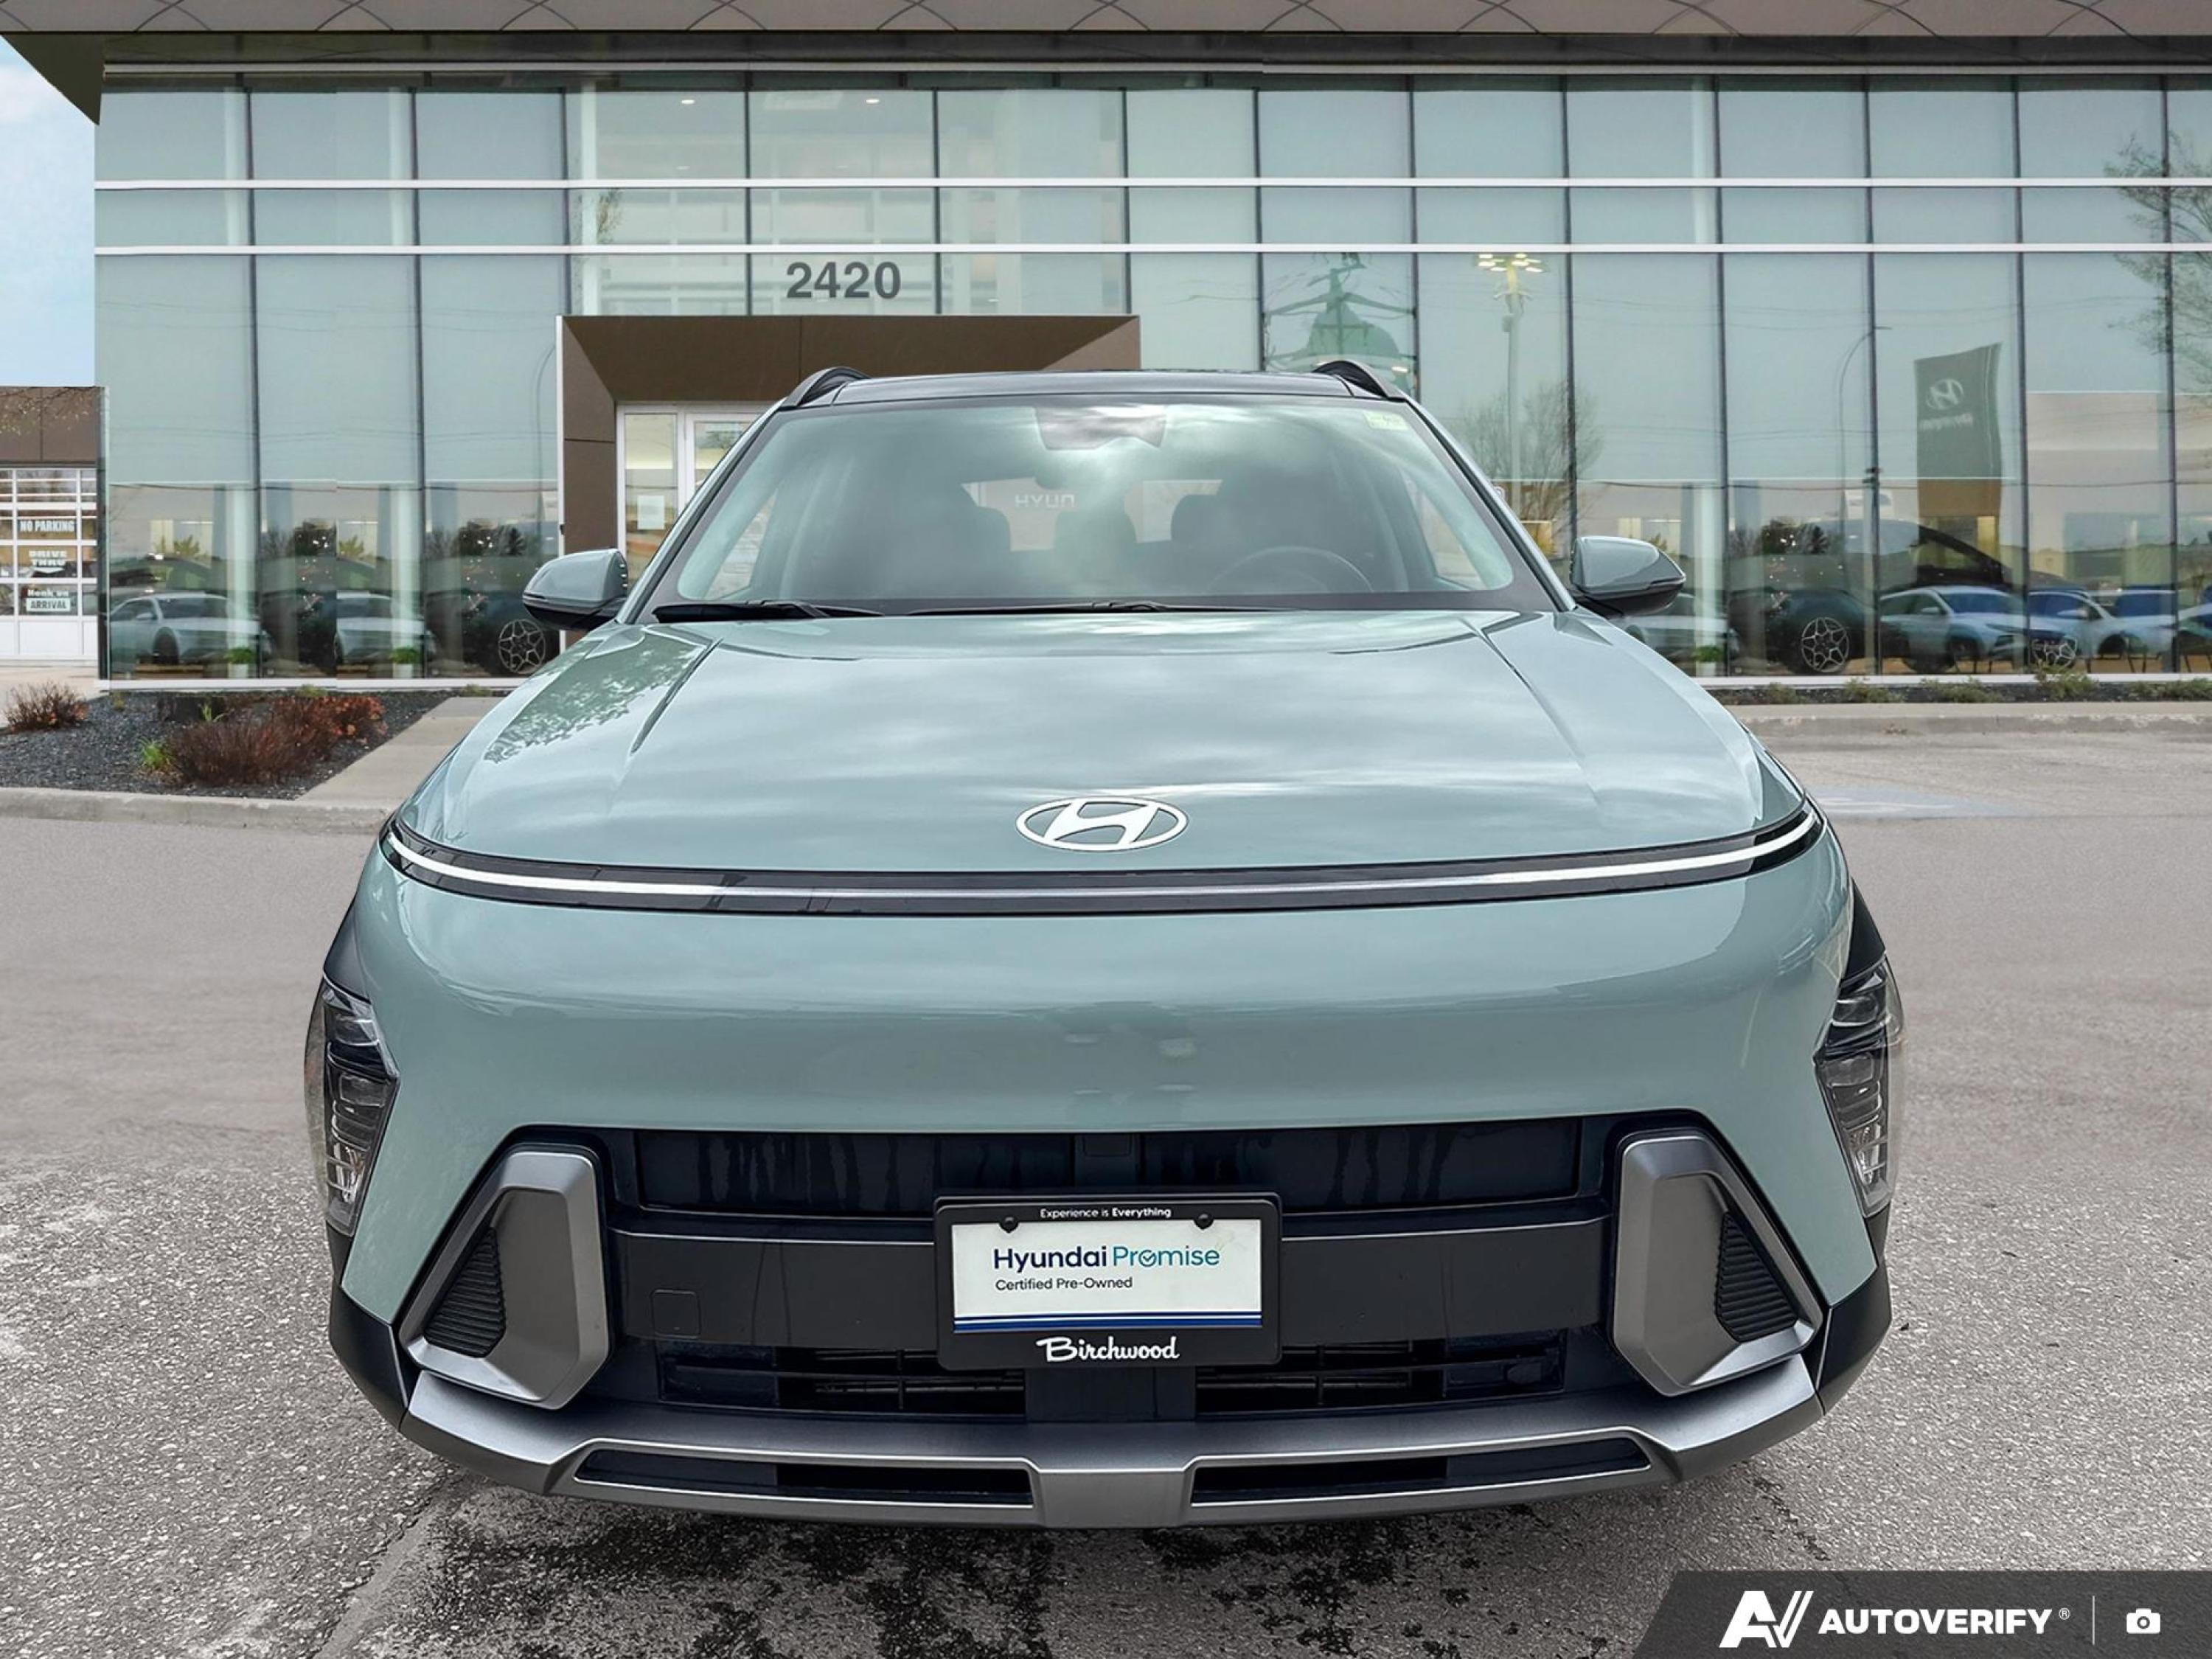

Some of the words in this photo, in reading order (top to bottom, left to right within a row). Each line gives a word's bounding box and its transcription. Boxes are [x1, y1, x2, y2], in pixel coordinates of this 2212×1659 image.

[786, 261, 901, 299] 2420
[20, 520, 33, 532] NO
[34, 520, 74, 532] PARKING
[30, 600, 67, 609] ARRIVAL
[1040, 1208, 1099, 1220] Experience
[1101, 1208, 1109, 1217] is
[1112, 1207, 1172, 1219] Everything
[992, 1245, 1107, 1273] Hyundai
[1112, 1245, 1220, 1267] Promise
[995, 1277, 1053, 1291] Certified
[1056, 1276, 1133, 1290] Pre-Owned
[1035, 1335, 1180, 1363] Birchwood
